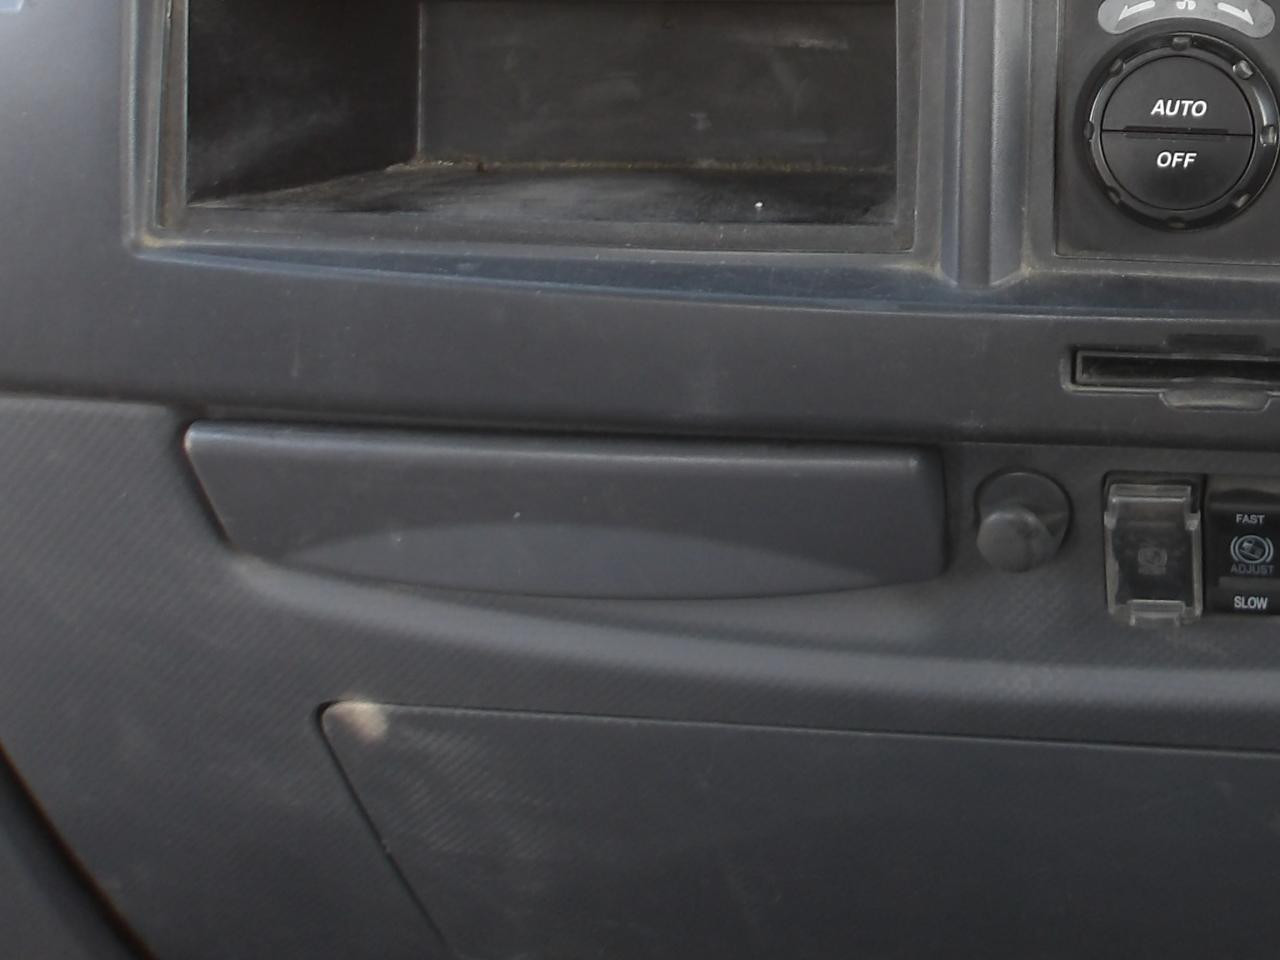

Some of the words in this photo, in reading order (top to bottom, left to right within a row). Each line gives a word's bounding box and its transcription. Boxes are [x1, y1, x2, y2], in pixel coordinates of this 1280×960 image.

[1150, 99, 1207, 117] AUTO
[1156, 151, 1198, 168] OFF
[1236, 514, 1265, 525] FAST
[1231, 563, 1275, 575] ADJUST
[1234, 596, 1268, 610] SLOW
